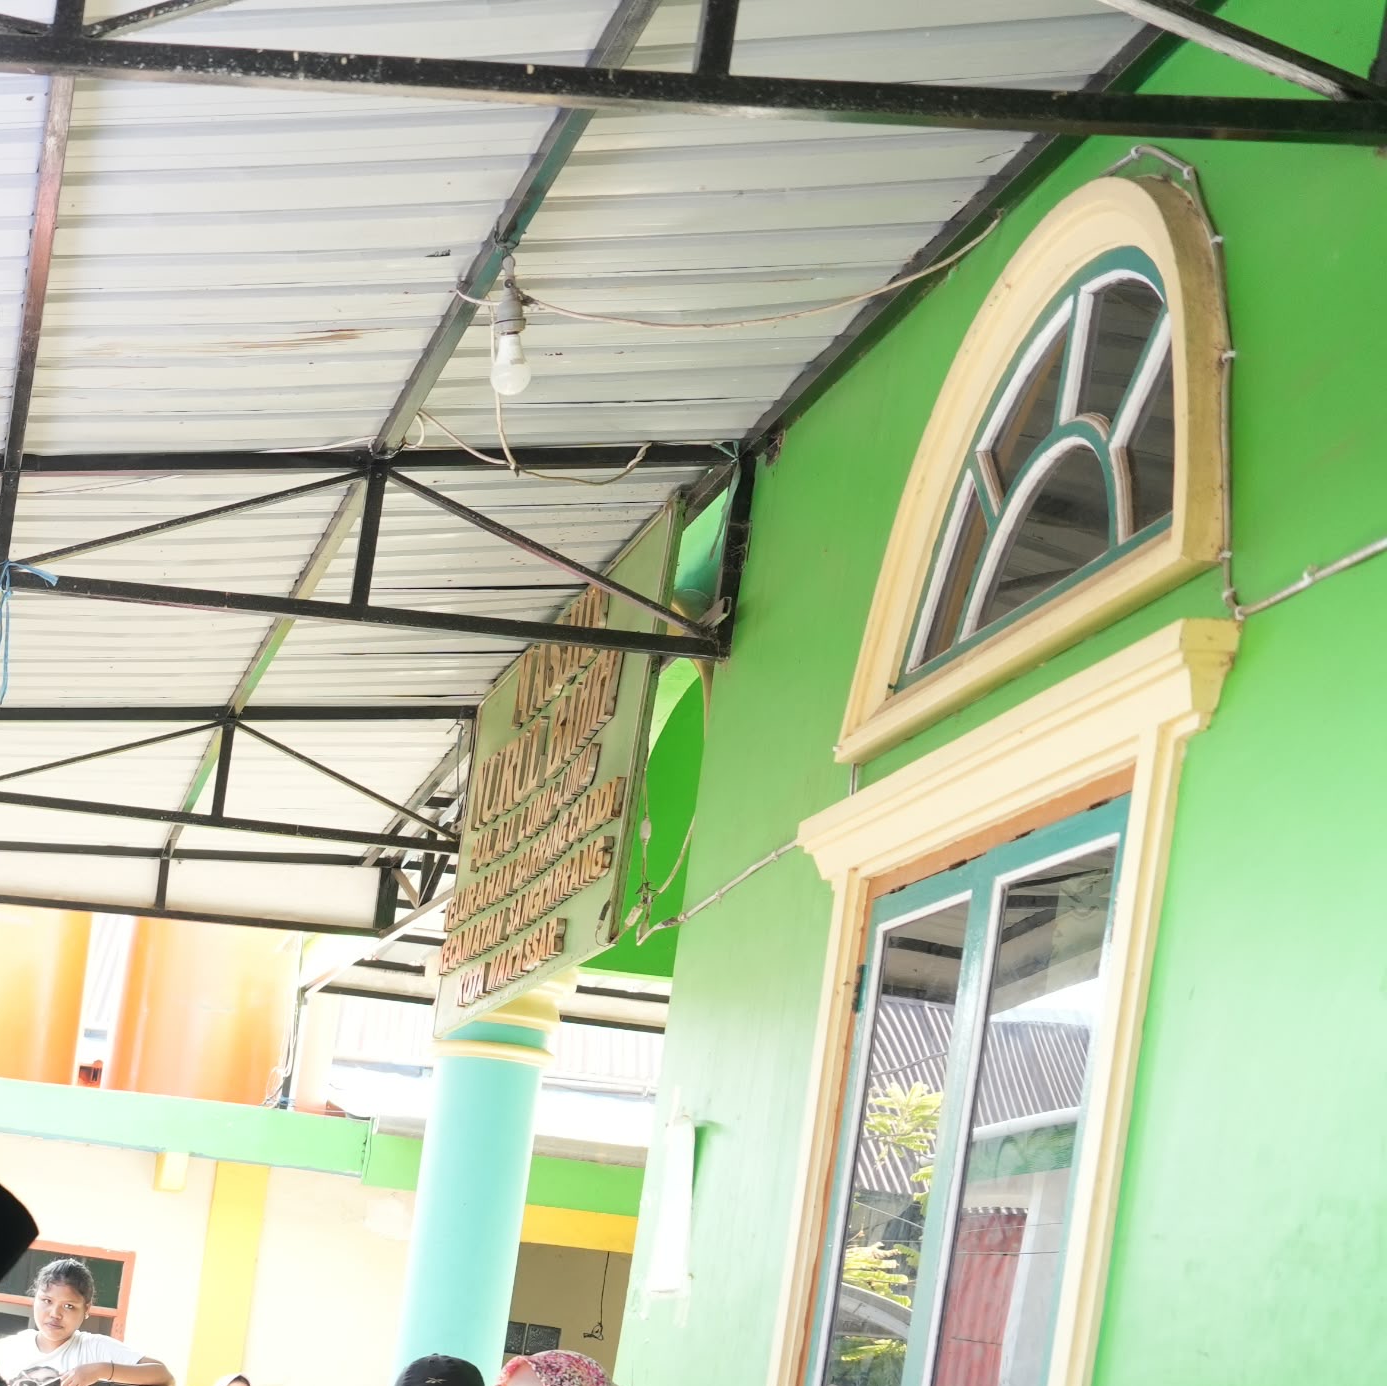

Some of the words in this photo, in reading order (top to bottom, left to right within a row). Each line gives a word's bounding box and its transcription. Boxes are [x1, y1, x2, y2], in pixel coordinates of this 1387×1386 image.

[474, 716, 549, 829] NURUL
[545, 650, 624, 779] BAHRI
[471, 814, 521, 872] PULAU
[519, 743, 601, 840] LUMU-LUMU
[439, 907, 510, 976] KECAMATAN
[507, 836, 614, 935] SANGKARRANG
[444, 861, 517, 932] KELURAHAN
[458, 962, 491, 1007] KOTA
[487, 918, 566, 994] MAKASSAR
